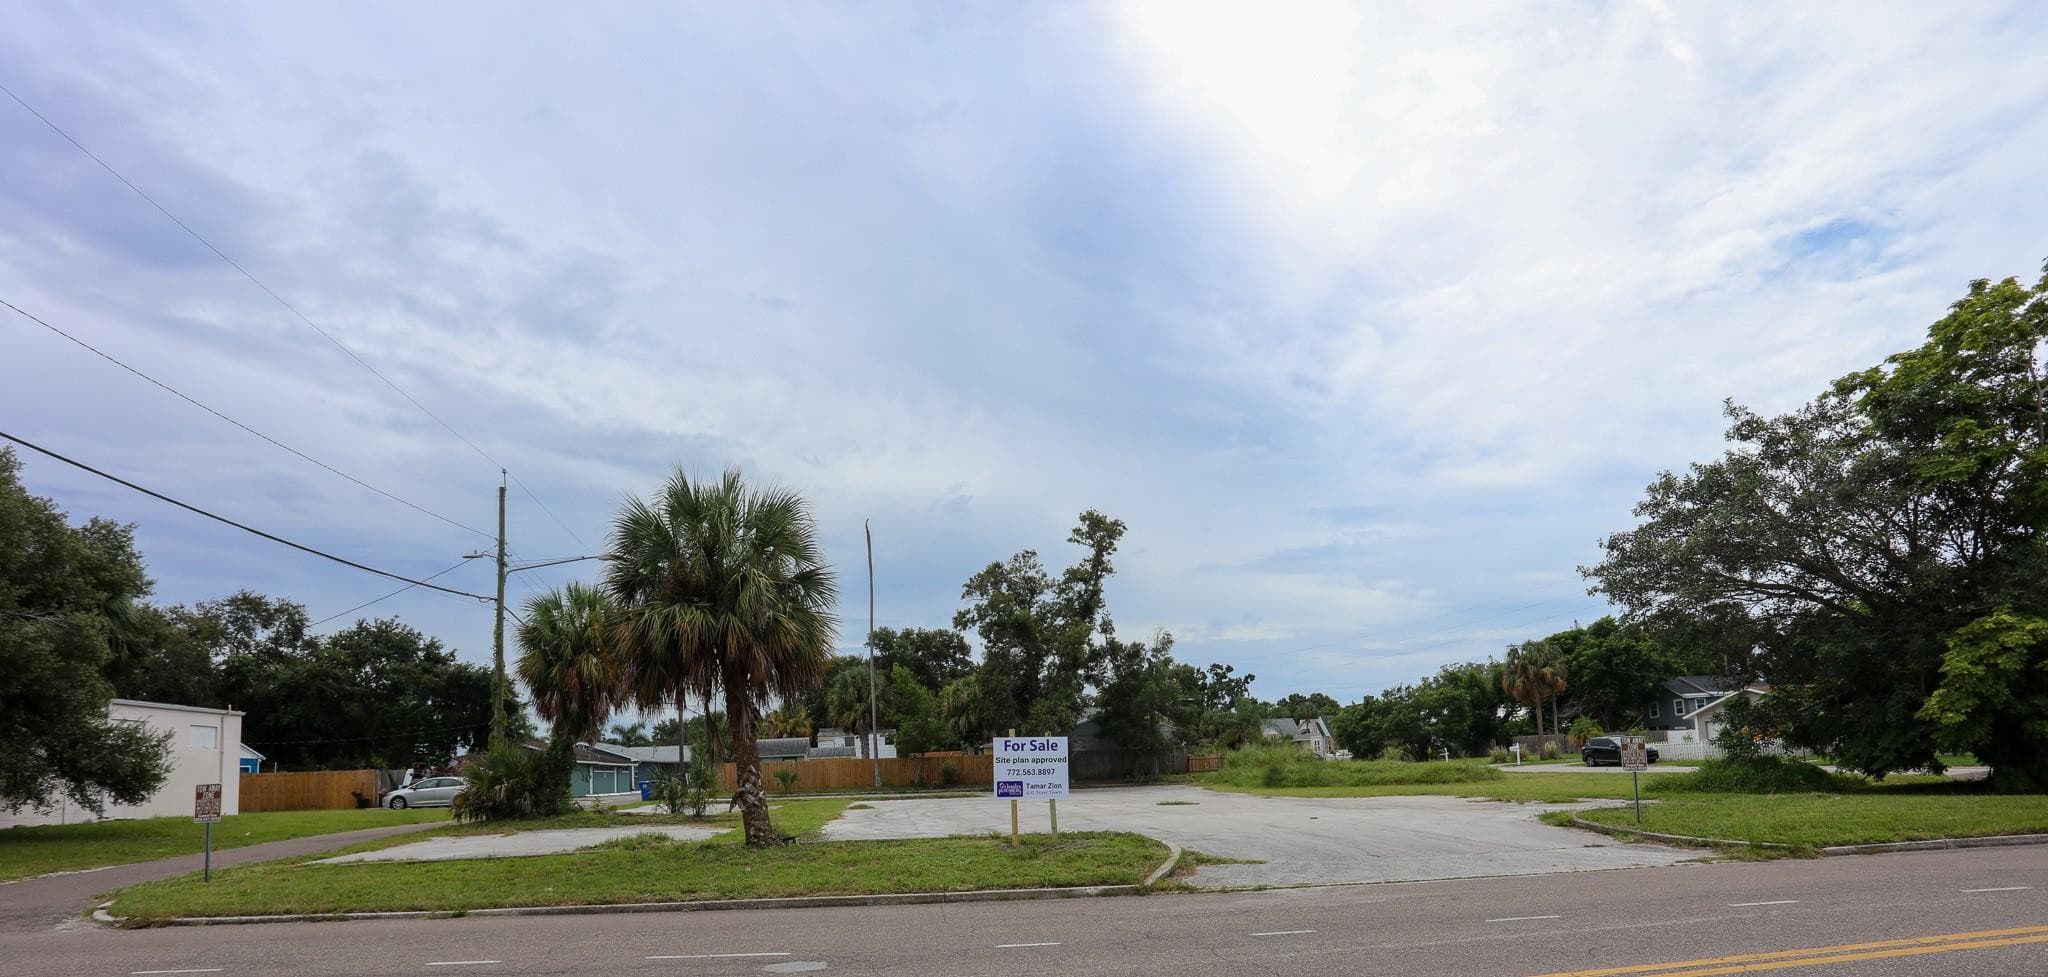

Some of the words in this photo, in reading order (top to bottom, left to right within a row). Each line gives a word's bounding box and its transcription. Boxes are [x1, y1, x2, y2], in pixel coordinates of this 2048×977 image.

[1004, 739, 1026, 752] For
[1029, 739, 1058, 752] Sale
[995, 756, 1011, 764] Site
[1012, 756, 1029, 765] plan
[1031, 755, 1067, 765] approved
[1007, 768, 1056, 776] 772.563.8897
